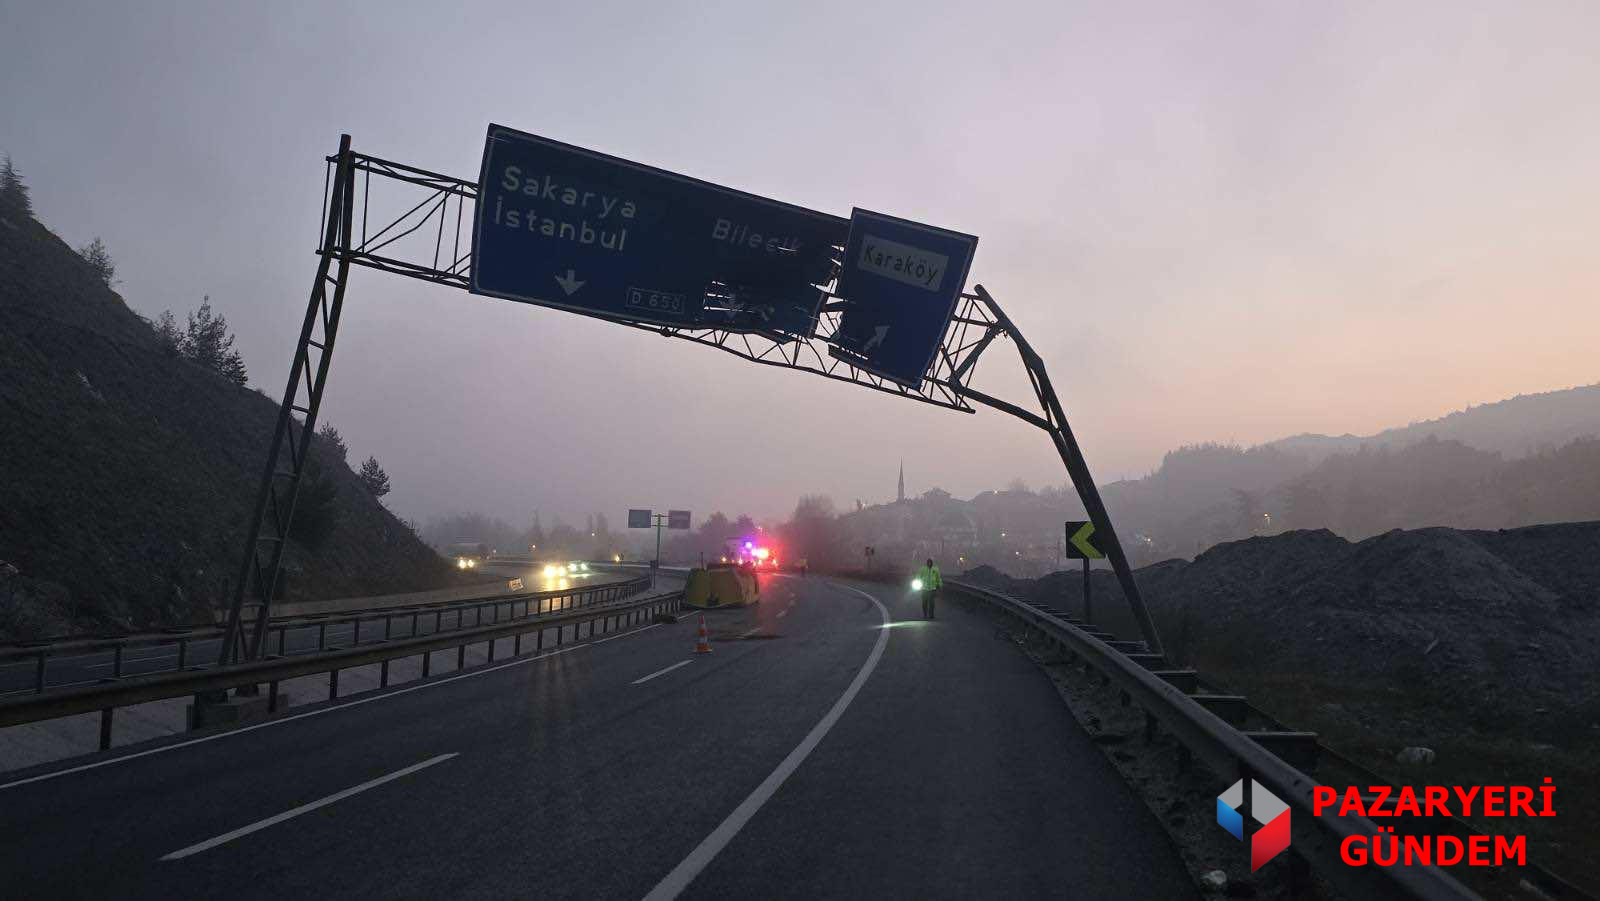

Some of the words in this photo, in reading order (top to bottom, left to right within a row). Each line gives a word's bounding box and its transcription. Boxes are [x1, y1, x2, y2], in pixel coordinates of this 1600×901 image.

[502, 165, 637, 219] Sakarya
[495, 194, 627, 252] İstanbul
[863, 244, 938, 284] Karaköy
[631, 291, 641, 304] D
